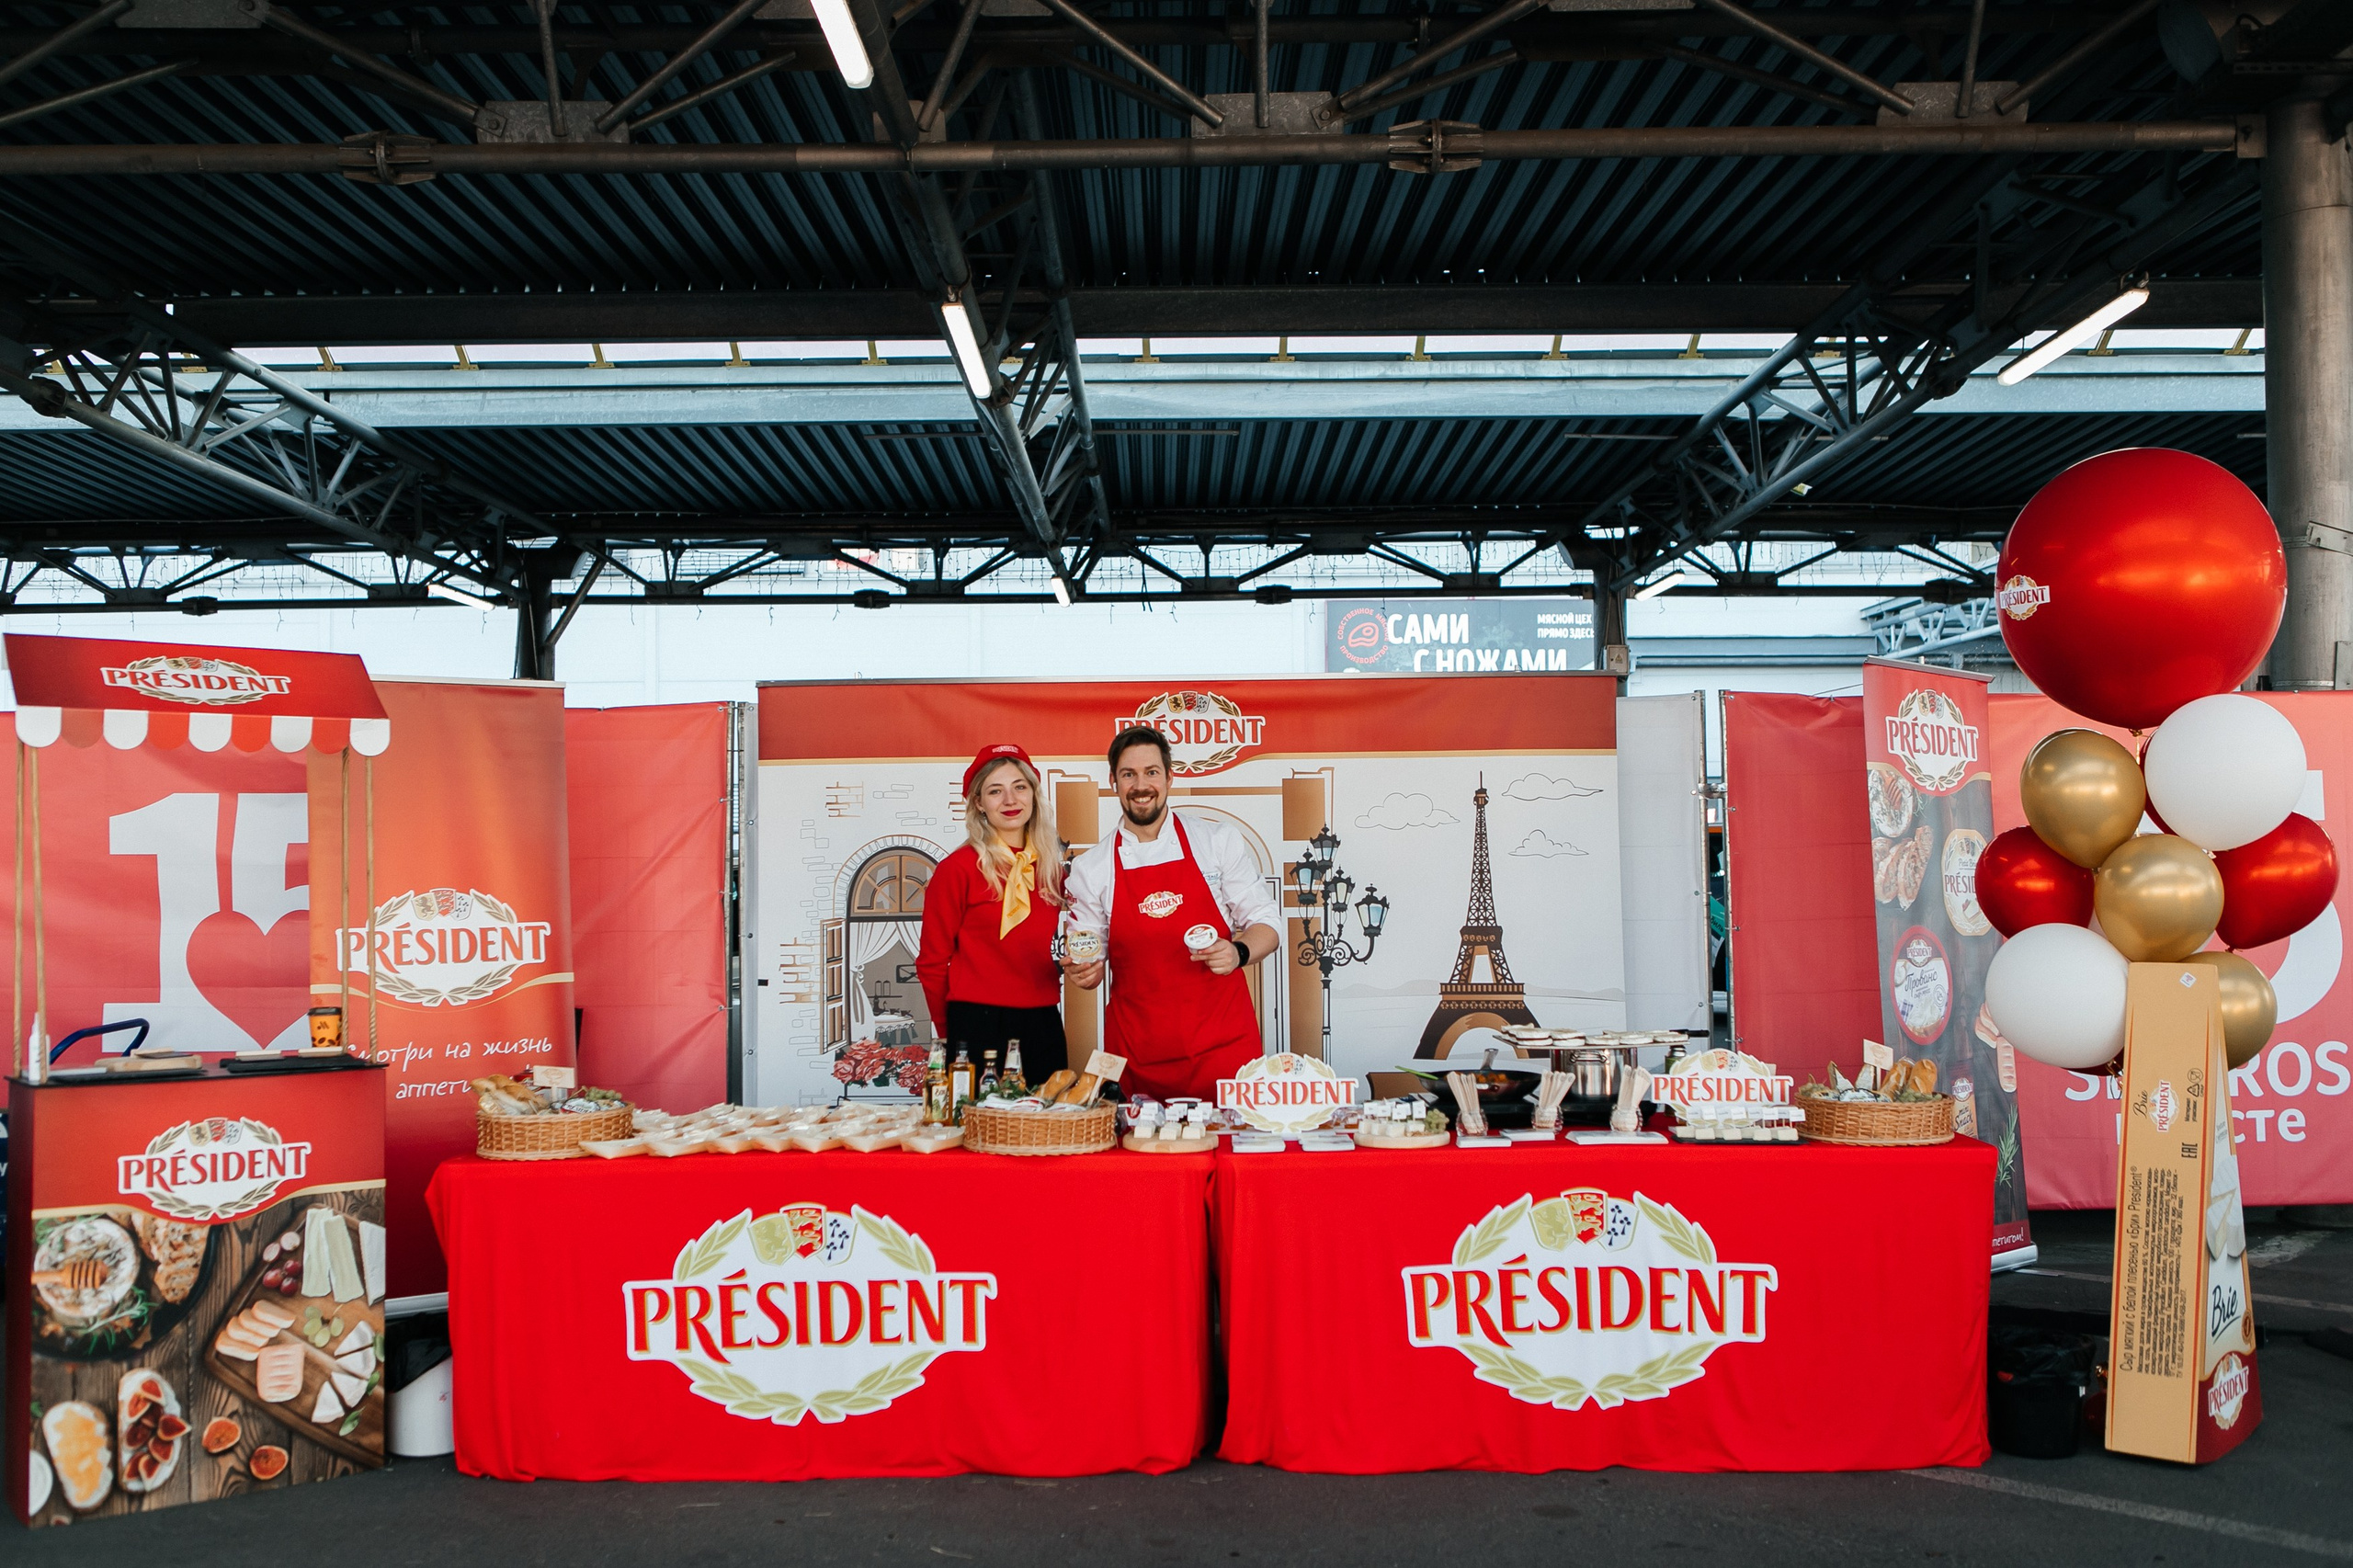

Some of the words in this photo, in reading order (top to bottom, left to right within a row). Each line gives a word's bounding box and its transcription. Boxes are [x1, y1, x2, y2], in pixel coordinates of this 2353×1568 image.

[1337, 608, 1374, 640] СОБСТВЕННОЕ
[1387, 613, 1469, 644] САМИ
[1537, 612, 1574, 625] МЯСНОЙ
[1574, 613, 1592, 625] ЦЕХ
[1537, 628, 1569, 639] ПРЯМО
[1340, 644, 1388, 665] ПРОИЗВОДСТВО
[1414, 649, 1430, 672] С
[1435, 648, 1567, 672] НОЖАМИ
[106, 669, 289, 693] PRÉSIDENT
[1888, 716, 1976, 760] PRÉSIDENT
[1944, 871, 1976, 896] PRÉSID
[1140, 895, 1182, 913] PRÉSIDENT
[343, 922, 547, 974] PRÉSIDENT
[445, 1041, 471, 1059] на
[483, 1037, 552, 1056] жизнь
[1220, 1077, 1356, 1110] PRÉSIDENT
[1654, 1074, 1790, 1107] PRÉSIDENT
[2132, 1090, 2148, 1119] Brie
[2157, 1081, 2169, 1131] PRÉSIDENT
[123, 1145, 307, 1193] PRÉSIDENT
[2127, 1243, 2139, 1283] плесенью
[1409, 1253, 1772, 1349] PRÉSIDENT
[2123, 1286, 2136, 1312] белой
[2211, 1284, 2238, 1337] Brie
[631, 1267, 989, 1365] PRÉSIDENT
[2122, 1322, 2134, 1350] мягкий
[2120, 1353, 2135, 1370] Сыр
[2209, 1369, 2249, 1414] PRÉSIDENT
